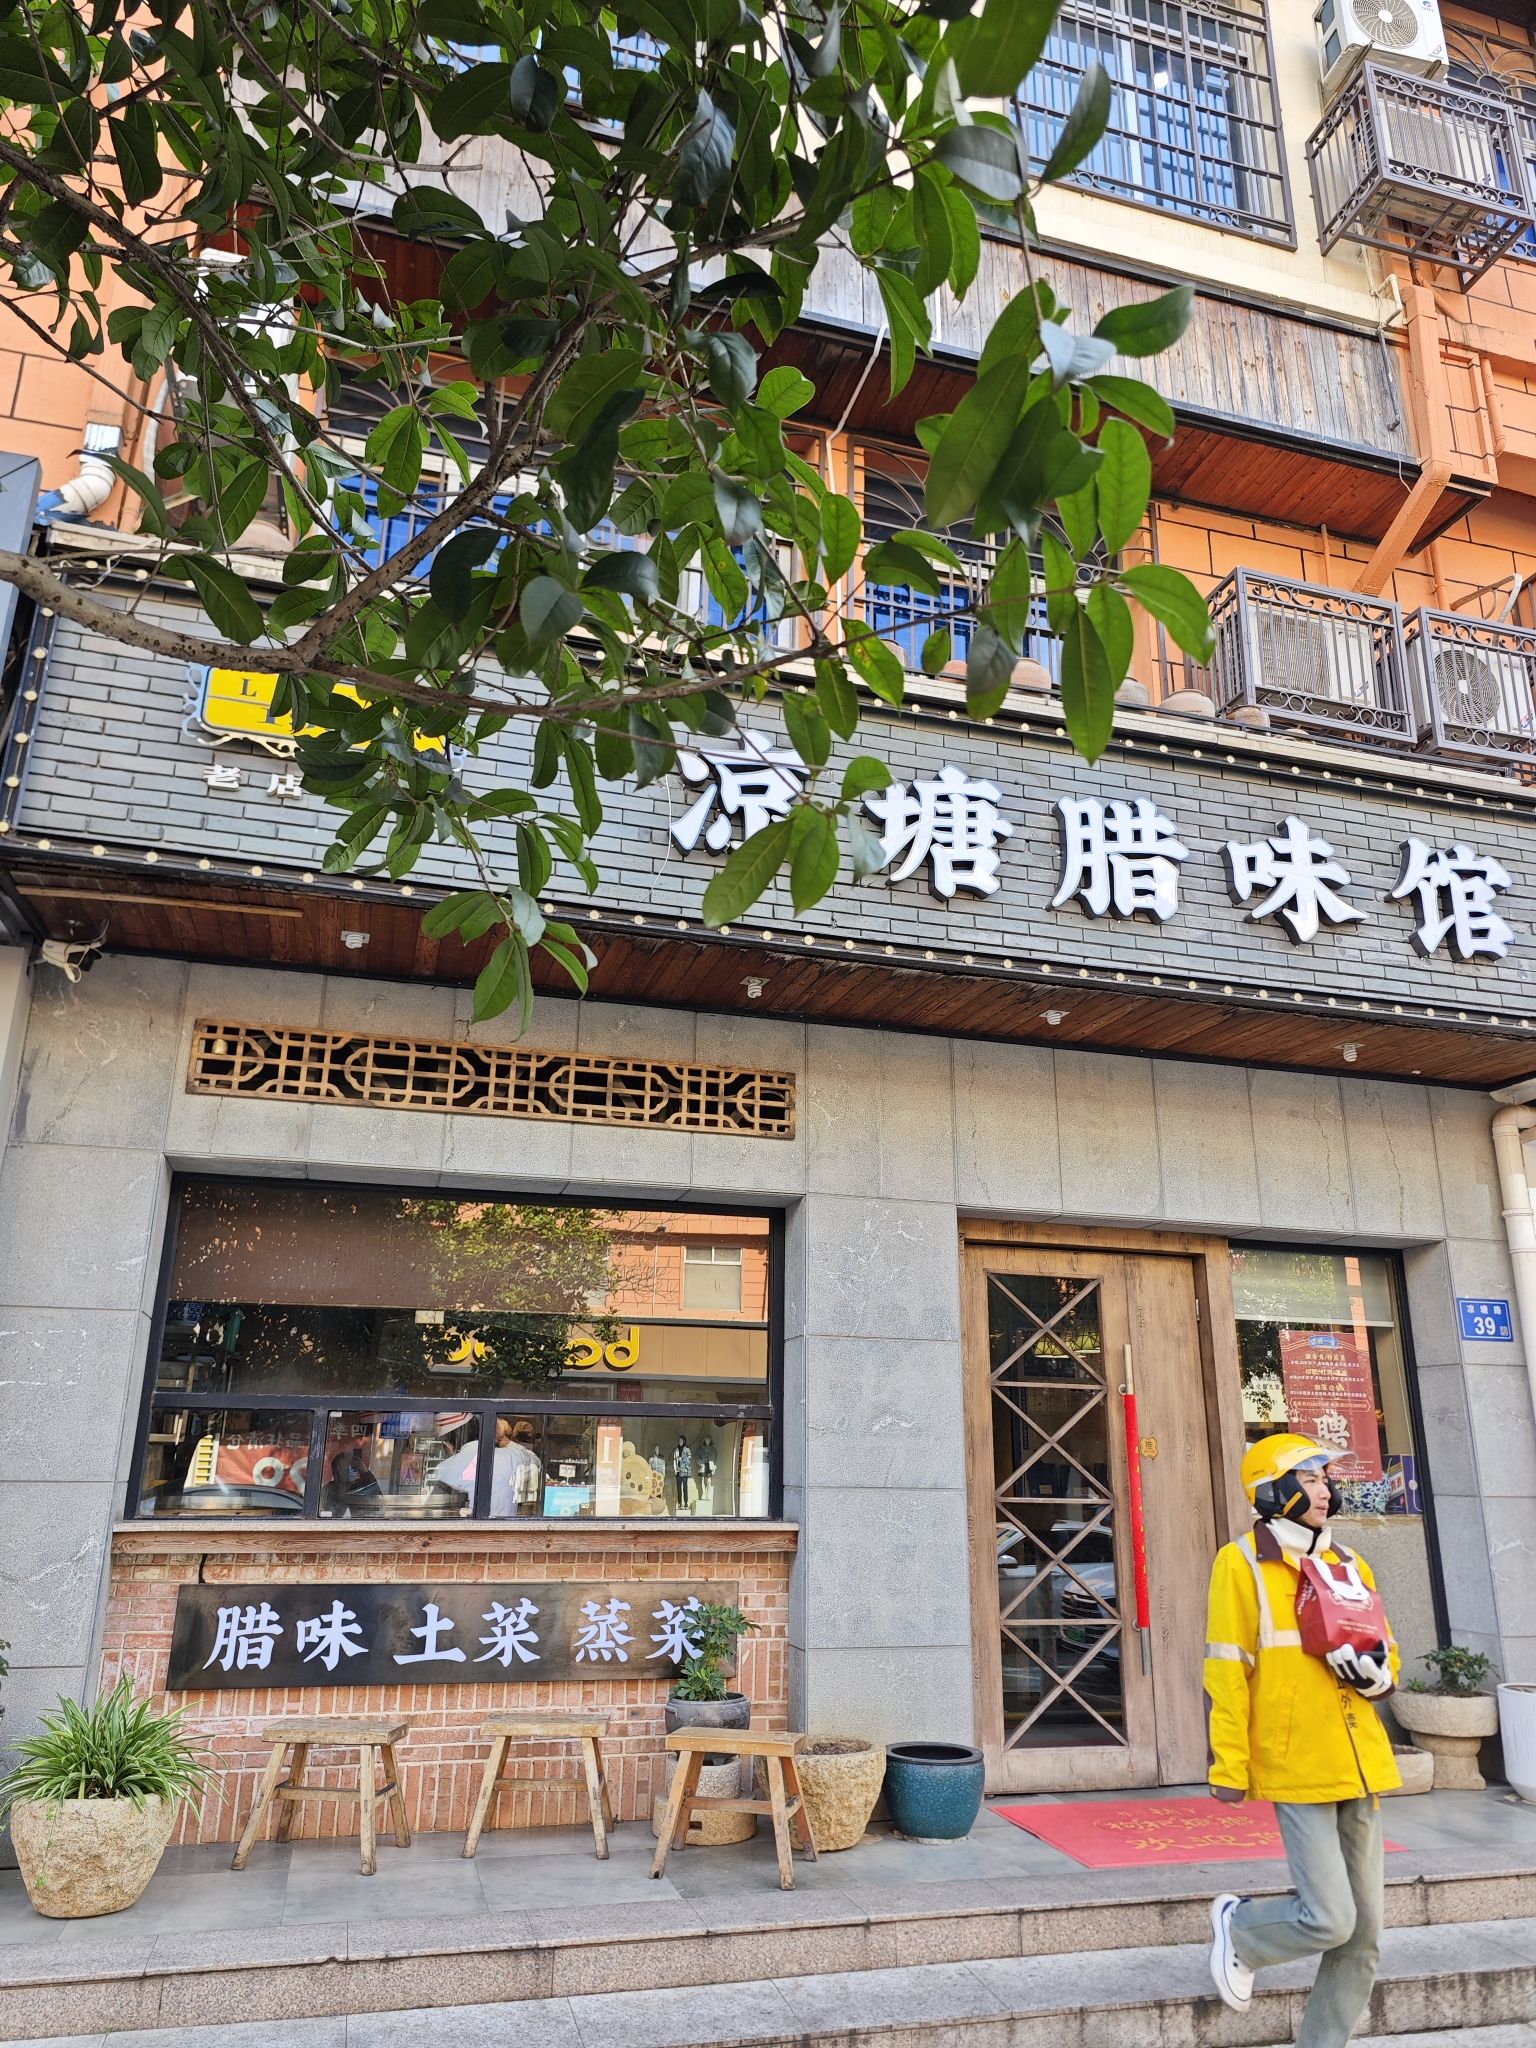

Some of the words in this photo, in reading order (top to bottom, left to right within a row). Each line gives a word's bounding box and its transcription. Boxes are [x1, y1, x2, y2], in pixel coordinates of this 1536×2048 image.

[670, 730, 1515, 960] 凉塘腊味馆
[1473, 1316, 1496, 1335] 39
